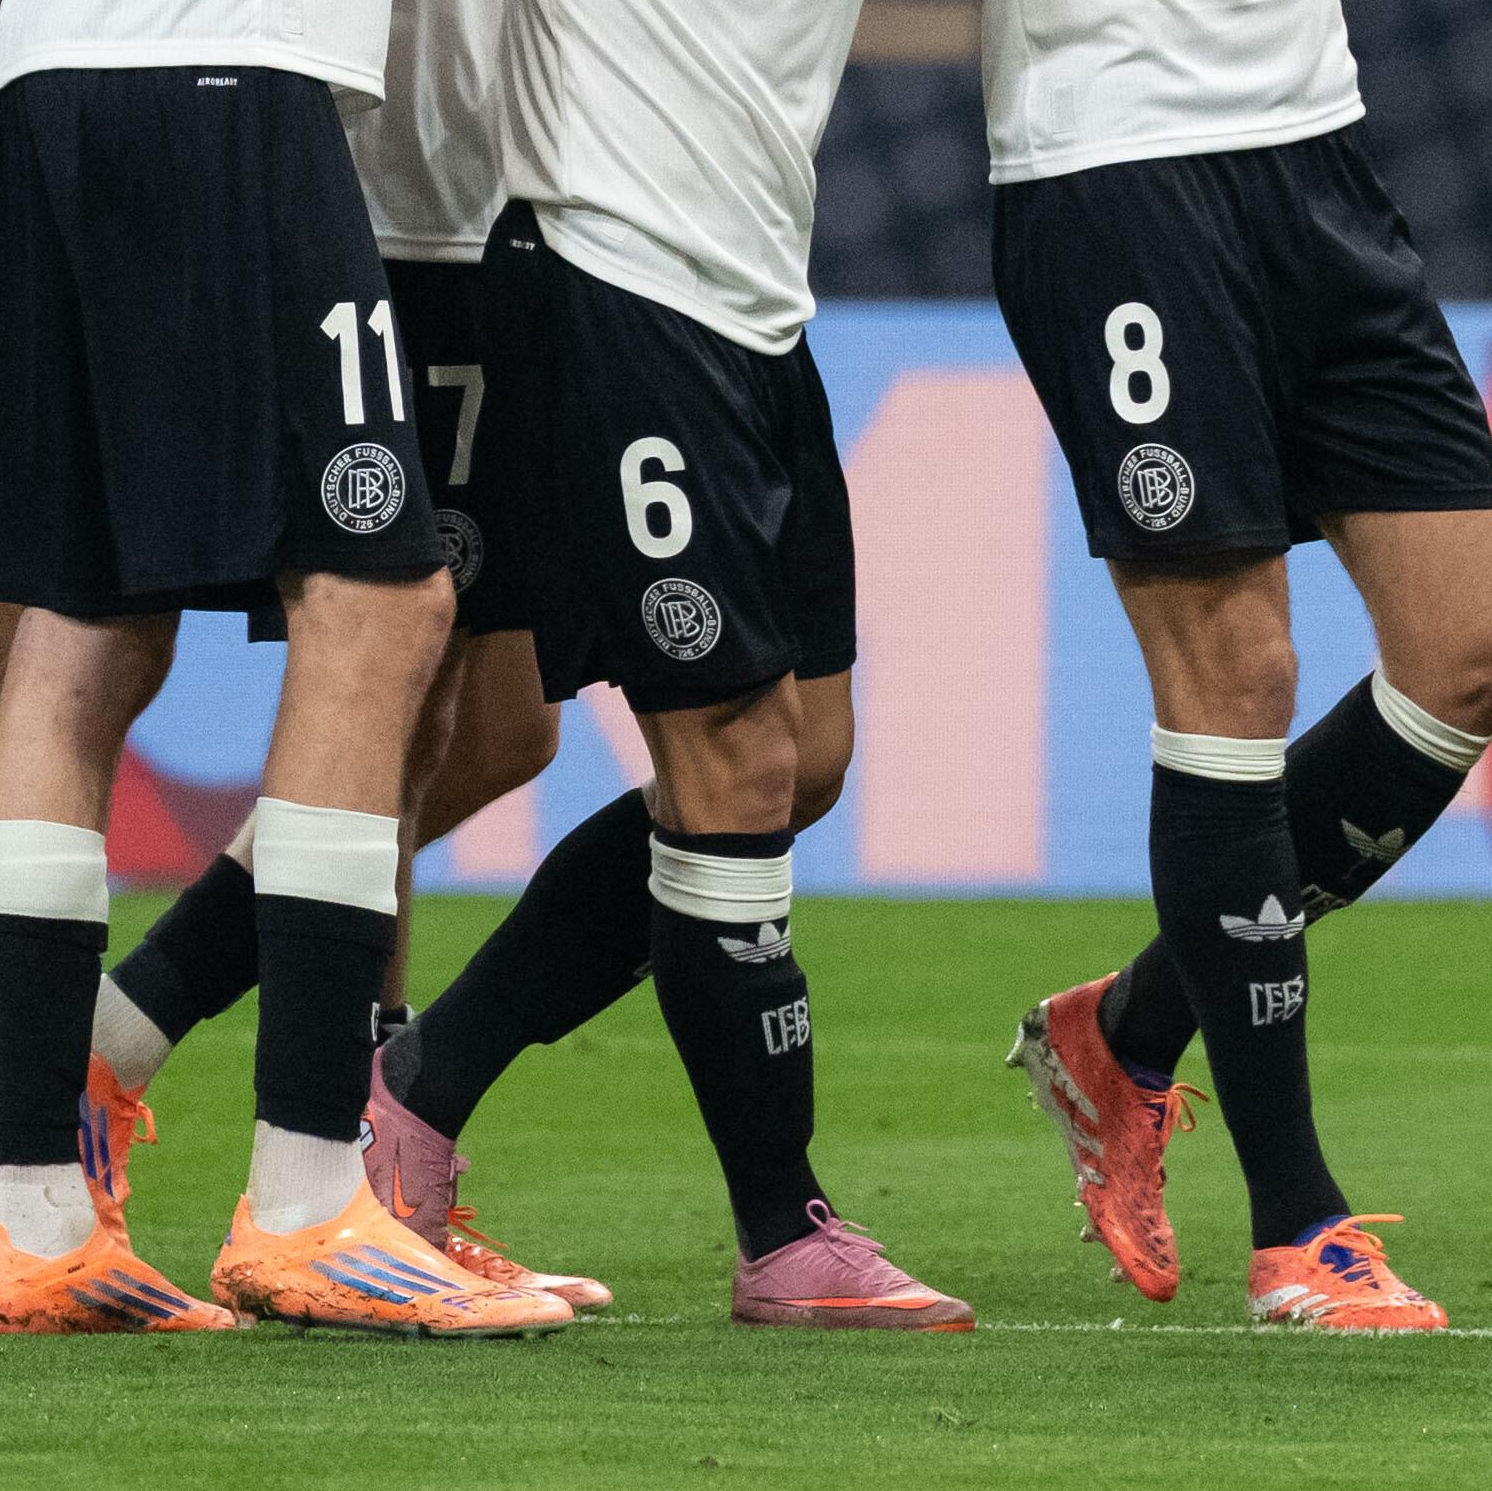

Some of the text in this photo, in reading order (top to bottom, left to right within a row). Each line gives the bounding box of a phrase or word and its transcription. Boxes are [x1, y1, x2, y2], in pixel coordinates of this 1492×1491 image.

[320, 299, 406, 425] 11
[1104, 301, 1171, 425] 8
[415, 365, 485, 486] 7
[620, 436, 694, 559] 6
